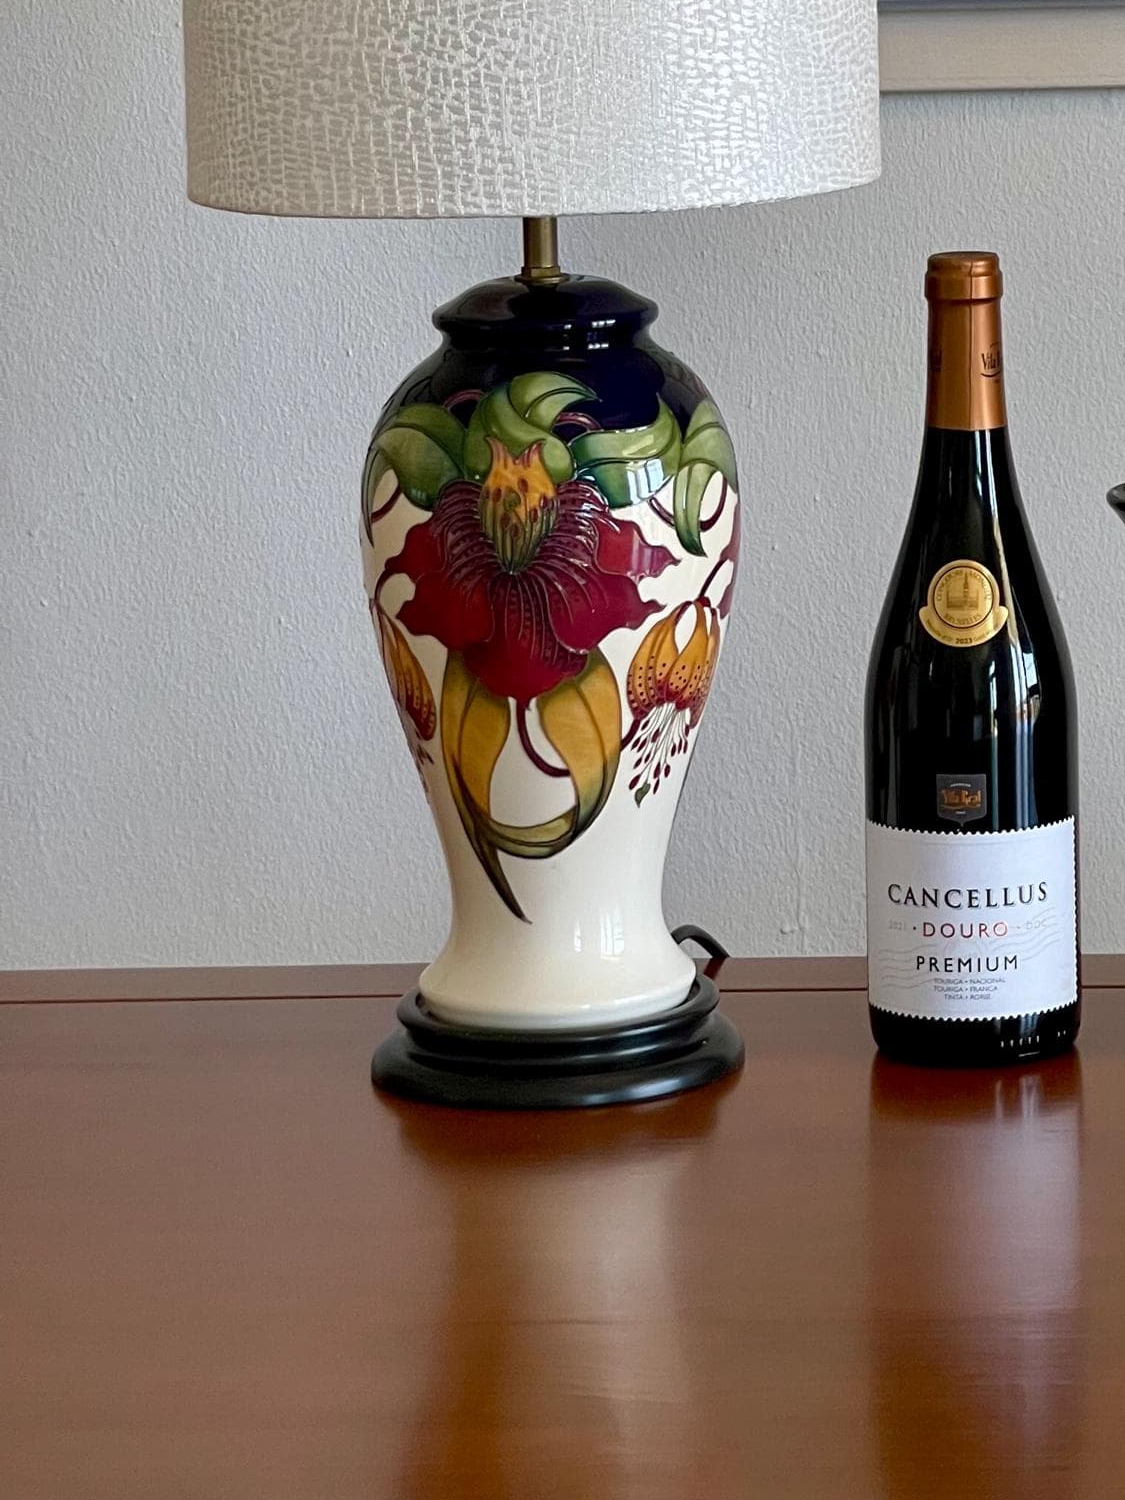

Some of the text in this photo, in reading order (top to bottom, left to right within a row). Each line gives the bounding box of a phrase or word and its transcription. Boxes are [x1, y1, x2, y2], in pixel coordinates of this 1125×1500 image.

[888, 881, 1048, 909] CANCELLUS
[922, 922, 1008, 938] DOURO
[916, 955, 1018, 973] PREMIUM
